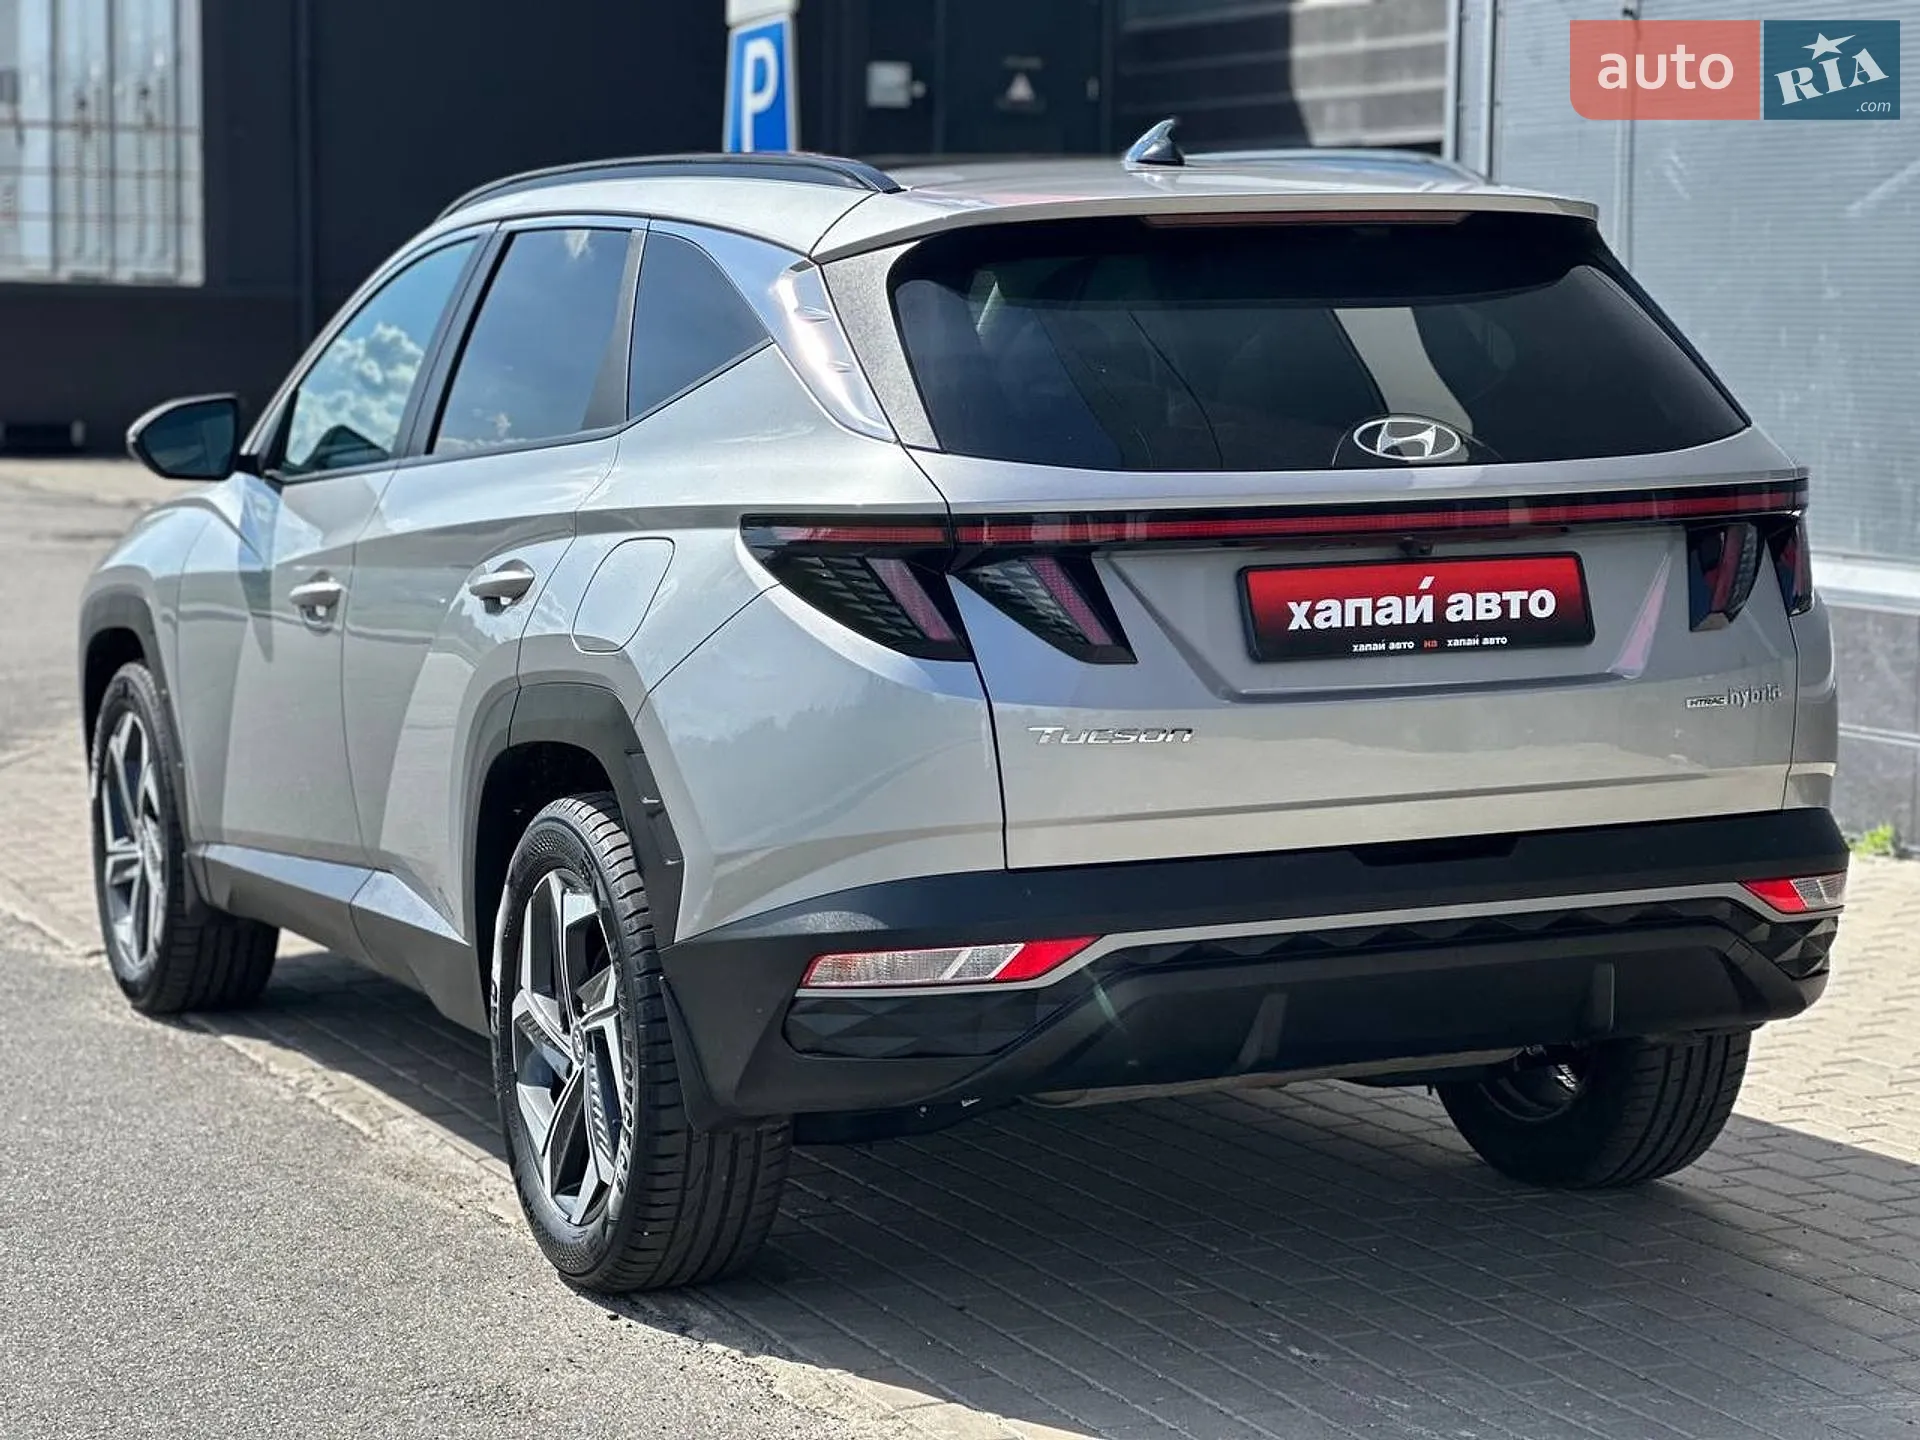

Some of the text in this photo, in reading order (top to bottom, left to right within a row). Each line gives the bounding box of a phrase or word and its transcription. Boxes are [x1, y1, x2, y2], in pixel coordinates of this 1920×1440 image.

[743, 37, 778, 153] P
[1287, 575, 1557, 631] хапай авто
